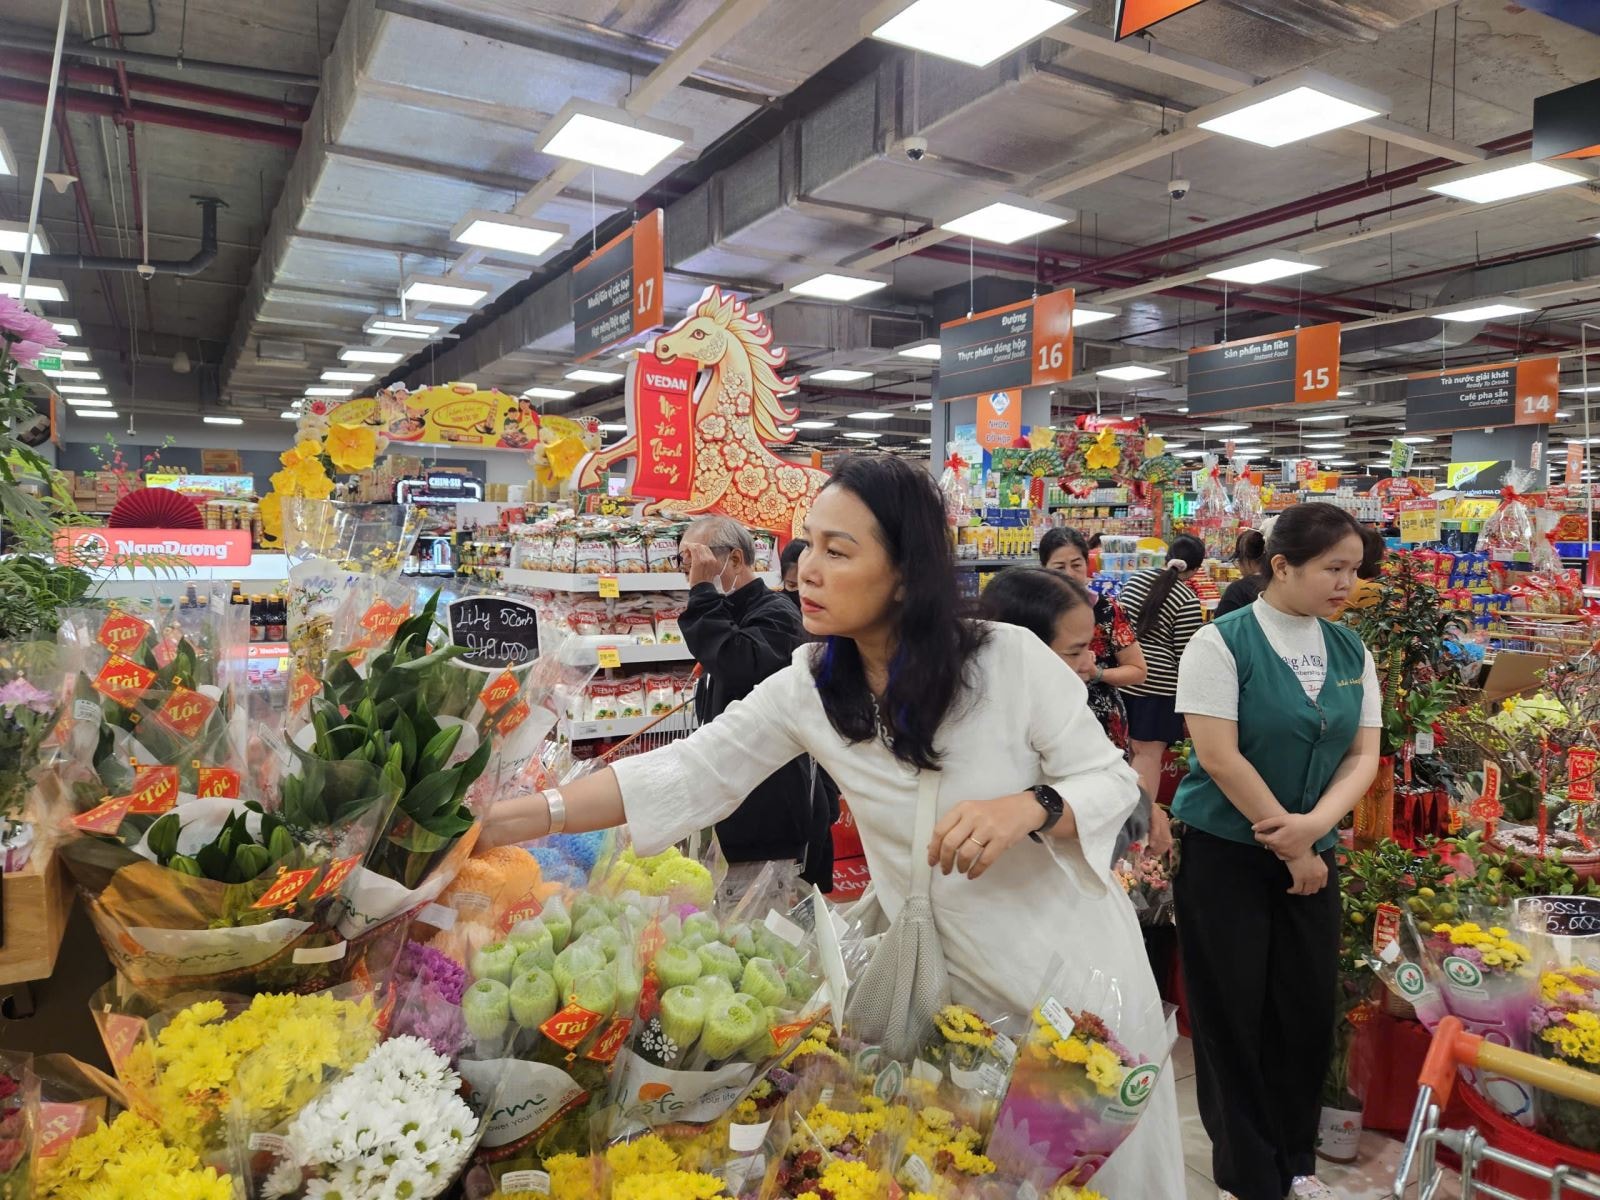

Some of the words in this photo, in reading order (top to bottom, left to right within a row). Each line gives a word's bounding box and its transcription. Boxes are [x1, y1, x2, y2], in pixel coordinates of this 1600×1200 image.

[637, 278, 654, 314] 17
[1002, 312, 1027, 326] Đường
[958, 351, 974, 362] Thực
[975, 345, 993, 359] phẩm
[994, 341, 1012, 354] đóng
[1012, 338, 1027, 351] hộp
[1038, 342, 1063, 371] 16
[1224, 349, 1238, 359] Sản
[1239, 345, 1261, 357] phẩm
[1262, 343, 1273, 352] ăn
[1273, 339, 1289, 349] liền
[1274, 350, 1288, 358] Food
[645, 374, 688, 391] VEDAN
[1303, 367, 1330, 390] 15
[1441, 376, 1454, 386] Trà
[1454, 375, 1475, 384] nước
[1476, 371, 1490, 382] giải
[1491, 370, 1509, 379] khát
[1459, 392, 1476, 402] Café
[1478, 391, 1493, 401] pha
[1523, 395, 1551, 414] 14
[428, 477, 462, 488] CHIN-SU
[108, 623, 138, 644] Tài
[463, 633, 528, 661] 249.000
[106, 671, 142, 692] Tài
[168, 701, 202, 723] Lộc
[139, 772, 172, 807] Tài
[555, 1016, 589, 1036] Tài
[600, 1028, 623, 1053] Lộc
